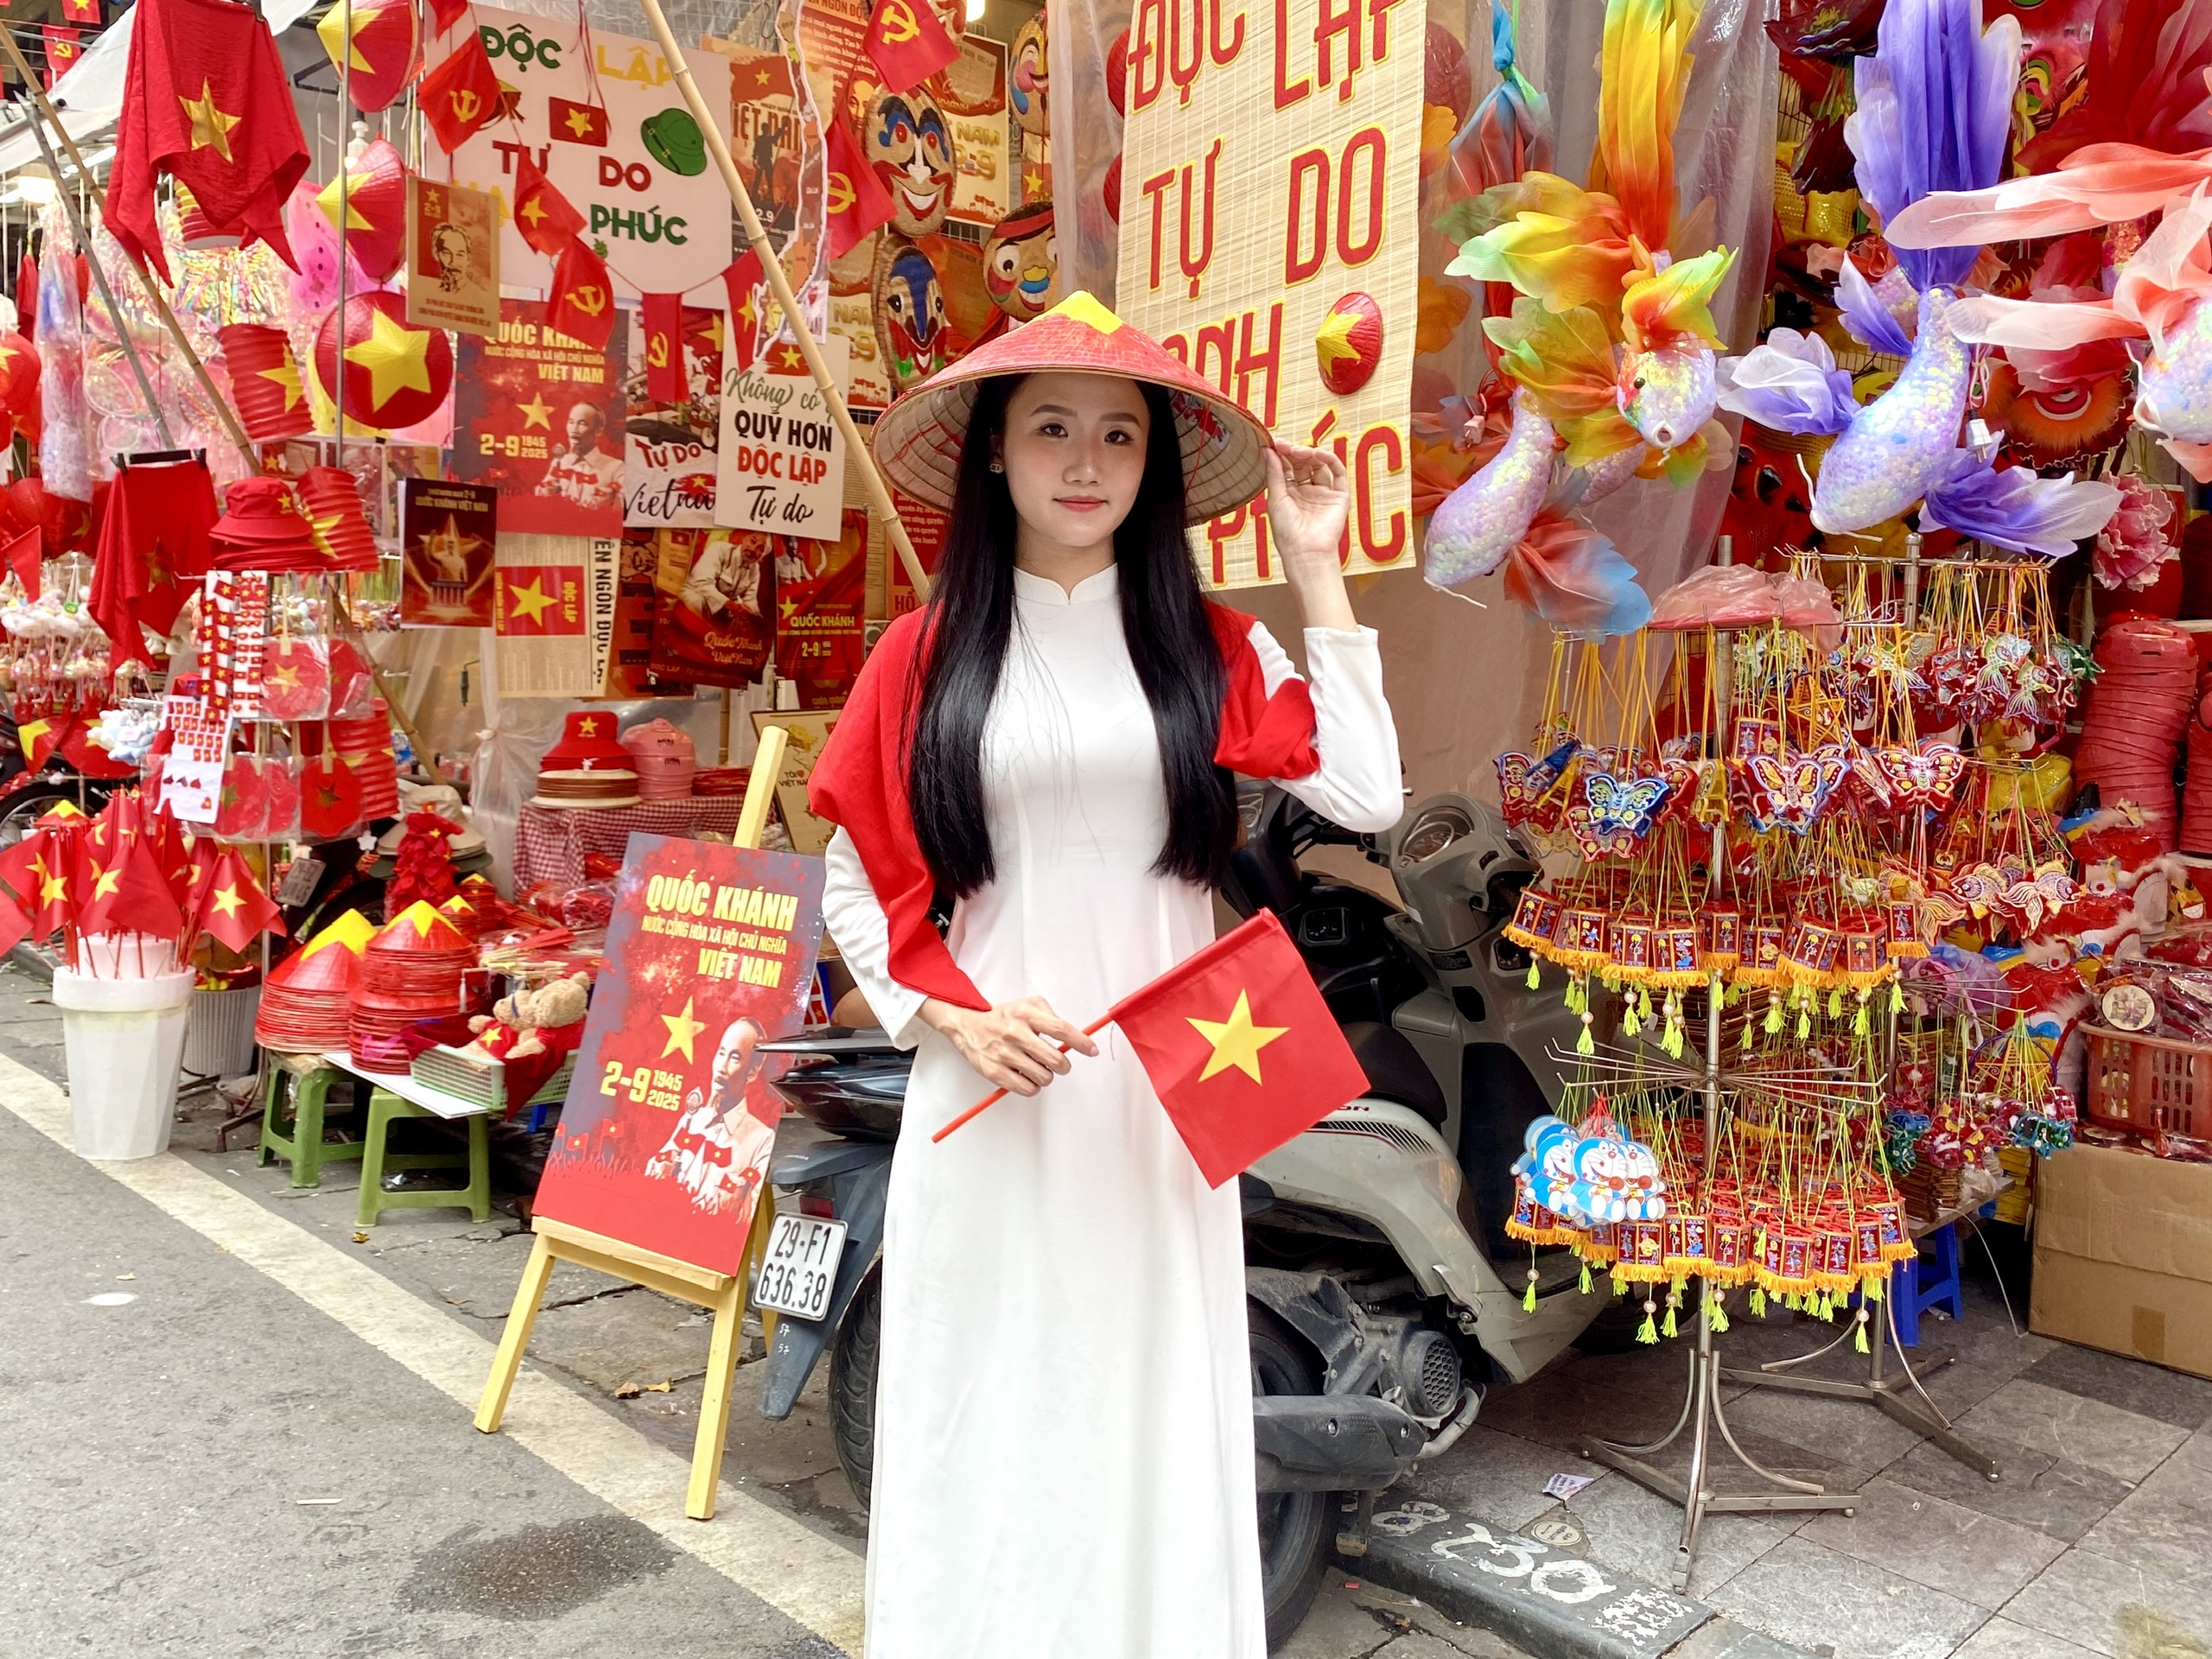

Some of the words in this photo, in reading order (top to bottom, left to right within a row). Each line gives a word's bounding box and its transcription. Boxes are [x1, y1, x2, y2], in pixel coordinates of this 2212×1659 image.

[480, 23, 562, 73] ĐỘC
[956, 122, 1001, 146] NAM
[599, 156, 652, 192] DO
[590, 205, 688, 245] PHÚC
[1142, 137, 1224, 299] TỰ
[1284, 124, 1389, 286] DO
[537, 363, 569, 383] VIỆT
[572, 366, 604, 384] NAM
[725, 367, 794, 407] Không
[480, 433, 520, 457] 2-9
[521, 435, 547, 447] 1945
[521, 448, 549, 459] 2025
[788, 419, 832, 453] HƠN
[634, 438, 668, 472] TỰ
[671, 443, 702, 464] DO
[737, 443, 783, 479] ĐỘC
[789, 451, 827, 486] LẬP
[747, 486, 777, 524] Tự
[783, 493, 814, 524] do
[563, 582, 577, 602] ĐỘC
[596, 569, 615, 614] NGÔN
[563, 604, 578, 623] LẬP
[790, 612, 820, 627] QUỐC
[822, 613, 855, 627] KHÁNH
[802, 641, 819, 657] 2-9
[645, 868, 711, 917] QUỐC
[712, 886, 799, 931] KHÁNH
[641, 915, 666, 934] NƯỚC
[665, 918, 690, 938] CỘNG
[708, 925, 723, 944] XÃ
[721, 927, 739, 948] HỘI
[738, 930, 759, 950] CHỦ
[758, 936, 788, 955] NGHĨA
[697, 947, 738, 982] VIỆT
[738, 956, 783, 988] NAM
[600, 1060, 652, 1103] 2-9
[652, 1070, 684, 1092] 1945
[646, 1089, 682, 1112] 2025
[759, 1262, 827, 1312] 636.38
